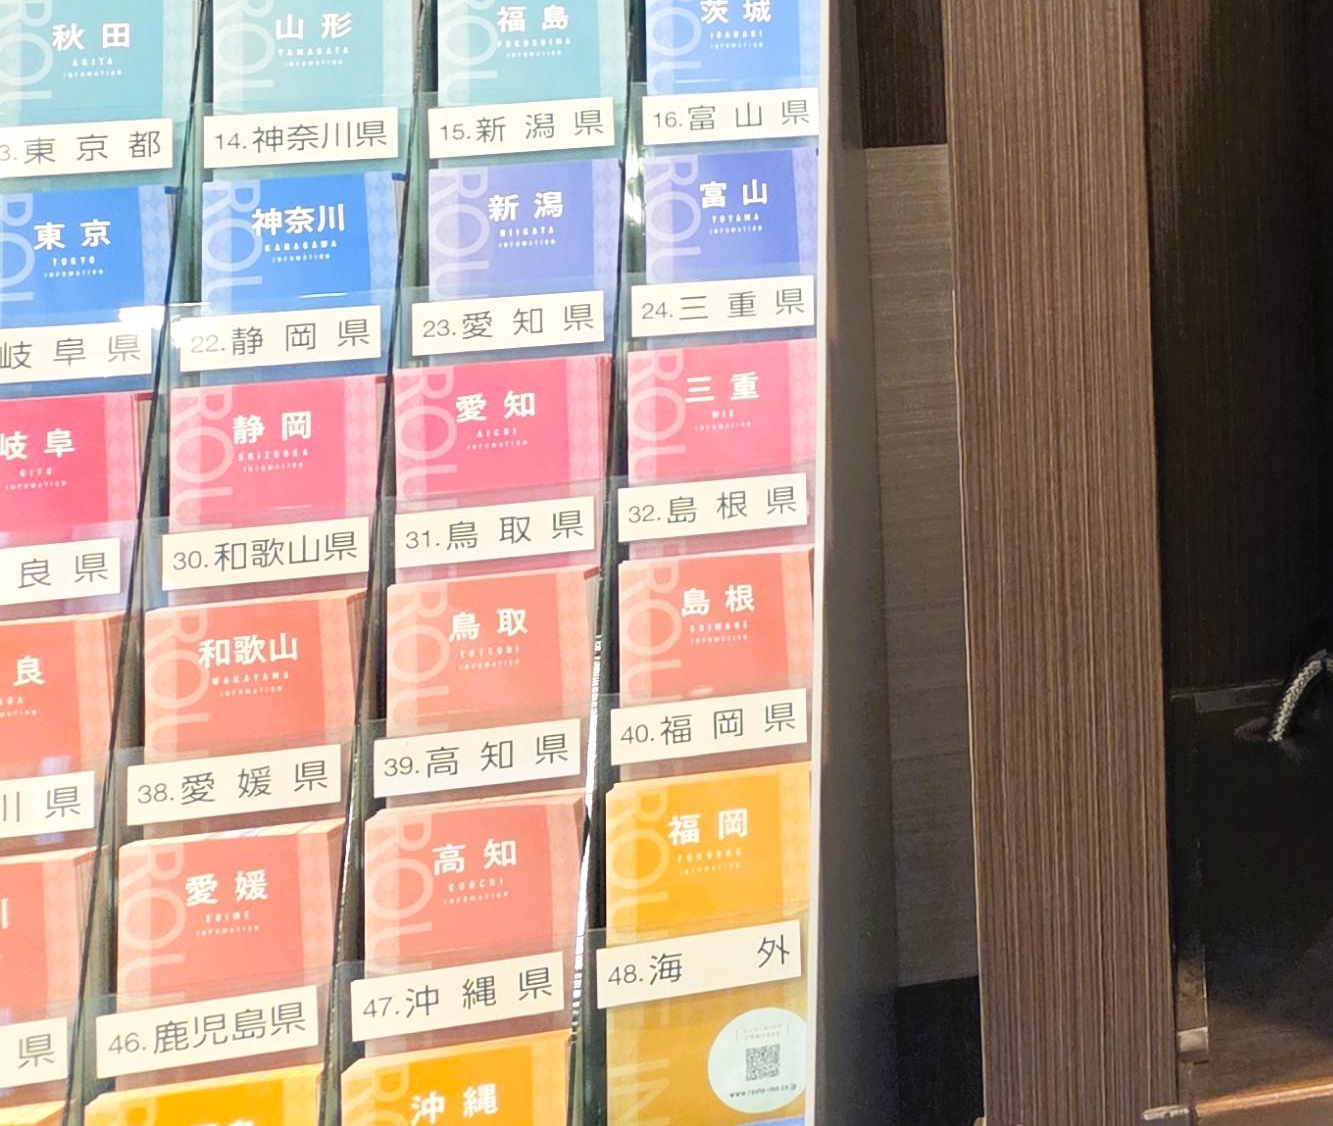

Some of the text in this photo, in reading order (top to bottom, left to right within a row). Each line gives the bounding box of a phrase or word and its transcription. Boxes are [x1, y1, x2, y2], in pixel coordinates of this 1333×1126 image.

[275, 12, 353, 40] 山形
[497, 5, 570, 32] 福島
[52, 22, 130, 52] 秋田
[488, 191, 564, 222] 新潟
[700, 179, 769, 208] 富山
[33, 218, 111, 250] 東京
[251, 204, 346, 237] 神奈川
[683, 371, 760, 403] 三重
[455, 390, 536, 423] 愛知
[0, 427, 76, 461] 岐阜
[232, 411, 313, 445] 静岡
[682, 584, 755, 617] 島根
[449, 608, 528, 642] 鳥取
[197, 632, 298, 670] 和歌山
[12, 655, 45, 687] 良
[668, 808, 748, 847] 福岡
[432, 839, 518, 876] 高知
[185, 869, 268, 907] 愛媛
[410, 1082, 499, 1126] 沖縄
